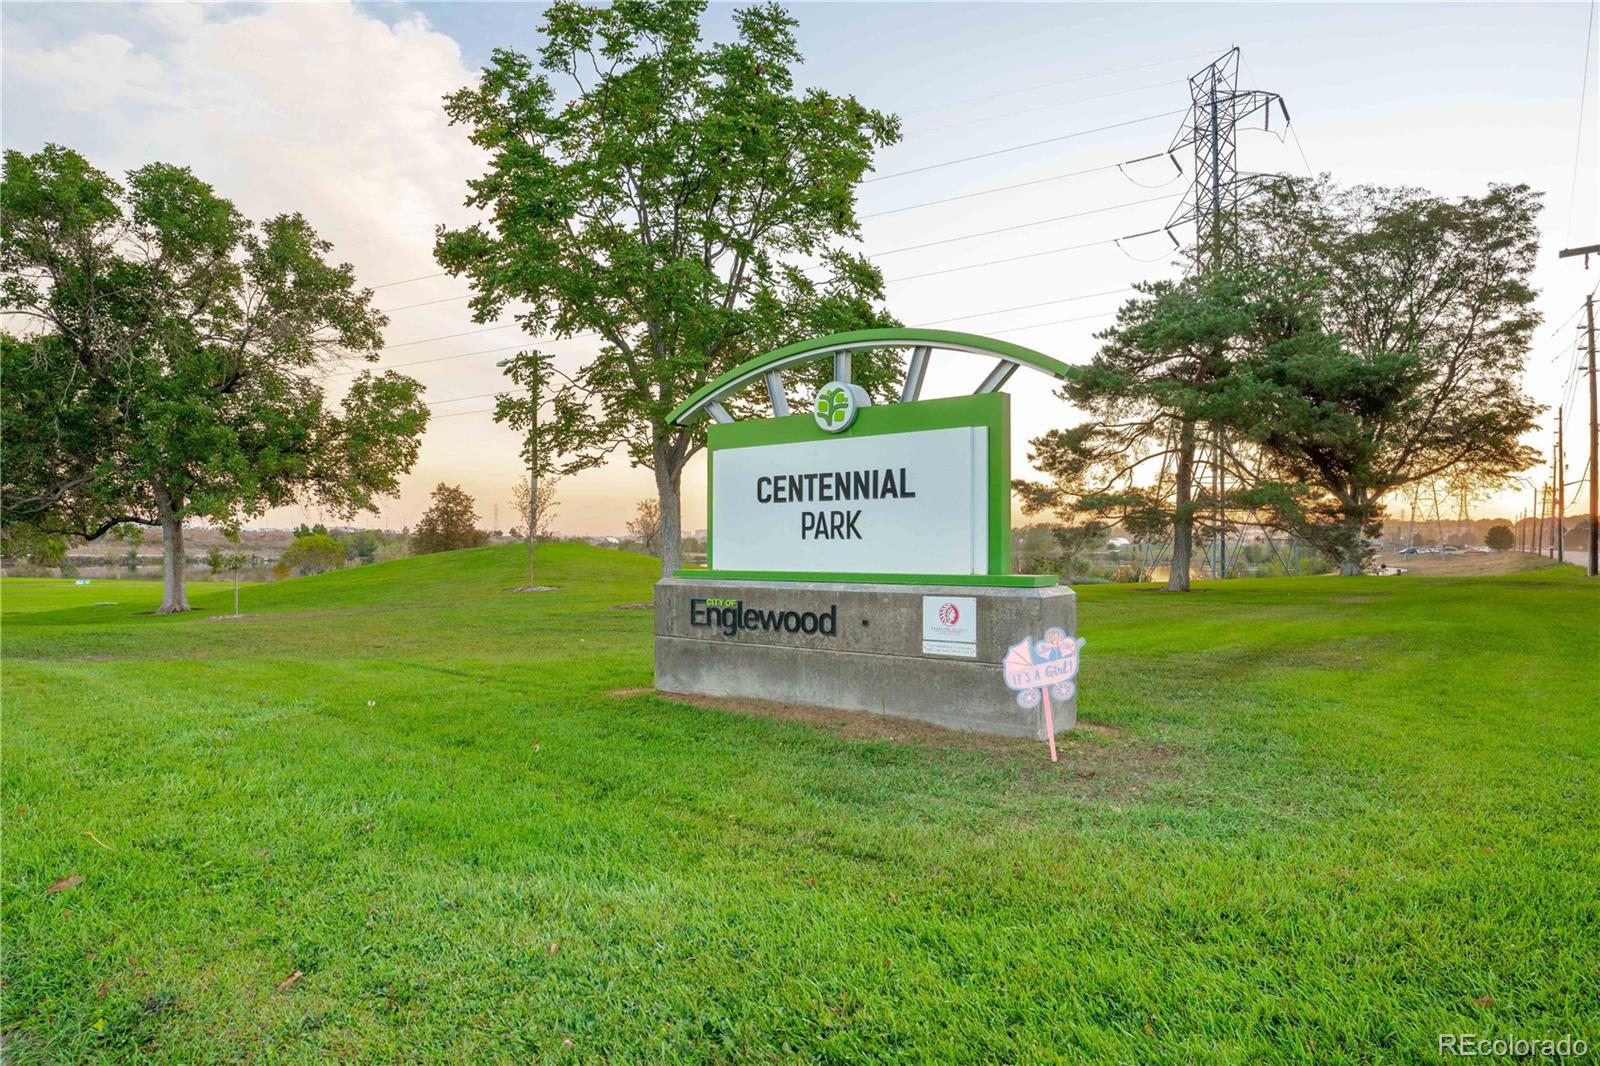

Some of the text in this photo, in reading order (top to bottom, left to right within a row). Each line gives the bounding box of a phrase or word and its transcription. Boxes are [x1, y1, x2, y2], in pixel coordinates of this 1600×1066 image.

[757, 468, 916, 504] CENTENNIAL
[801, 510, 863, 540] PARK
[690, 598, 838, 637] Englewood
[706, 598, 737, 607] CITY OF
[1034, 670, 1041, 680] A
